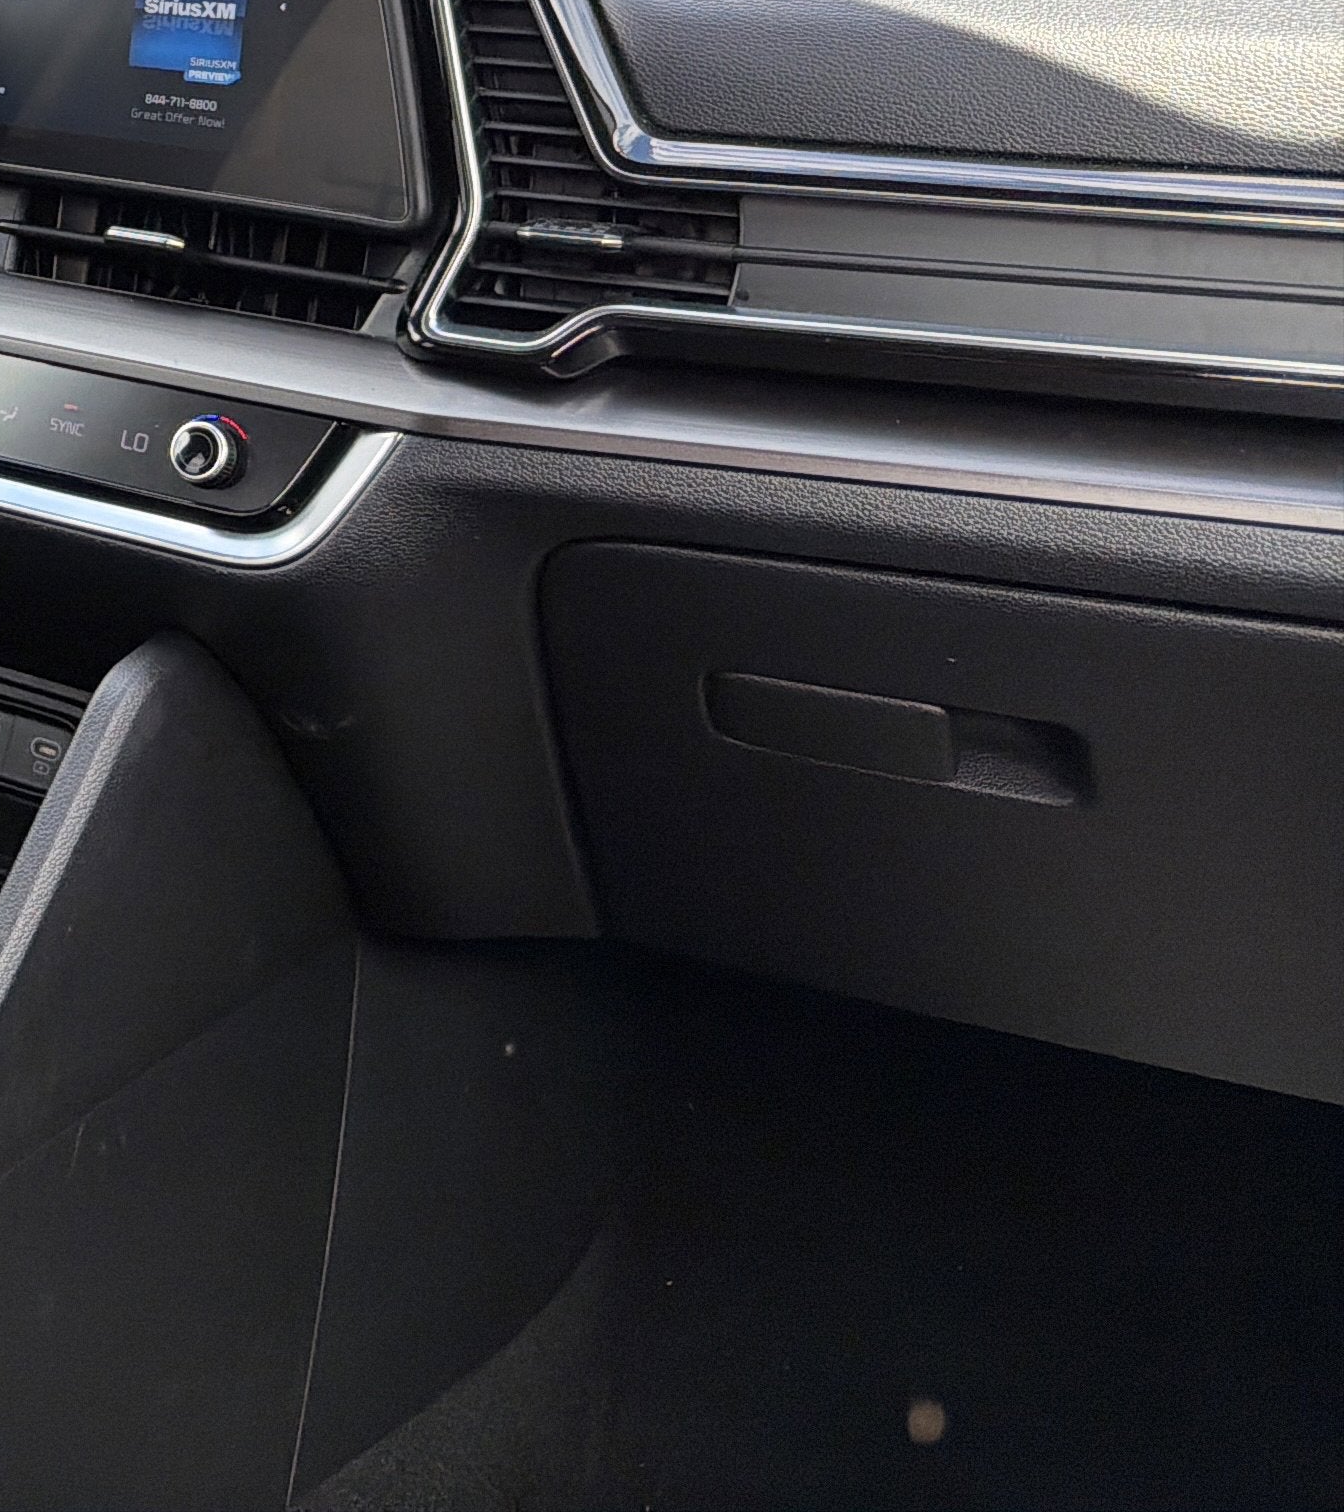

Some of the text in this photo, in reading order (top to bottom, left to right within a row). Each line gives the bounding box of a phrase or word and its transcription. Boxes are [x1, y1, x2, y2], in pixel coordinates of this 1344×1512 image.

[189, 56, 238, 71] SIRIUSXM
[188, 69, 236, 82] PREVIEW
[144, 93, 218, 112] 844-711-8800
[130, 107, 226, 129] Great Offer Now!
[50, 418, 85, 437] SYNC
[120, 429, 150, 453] LO
